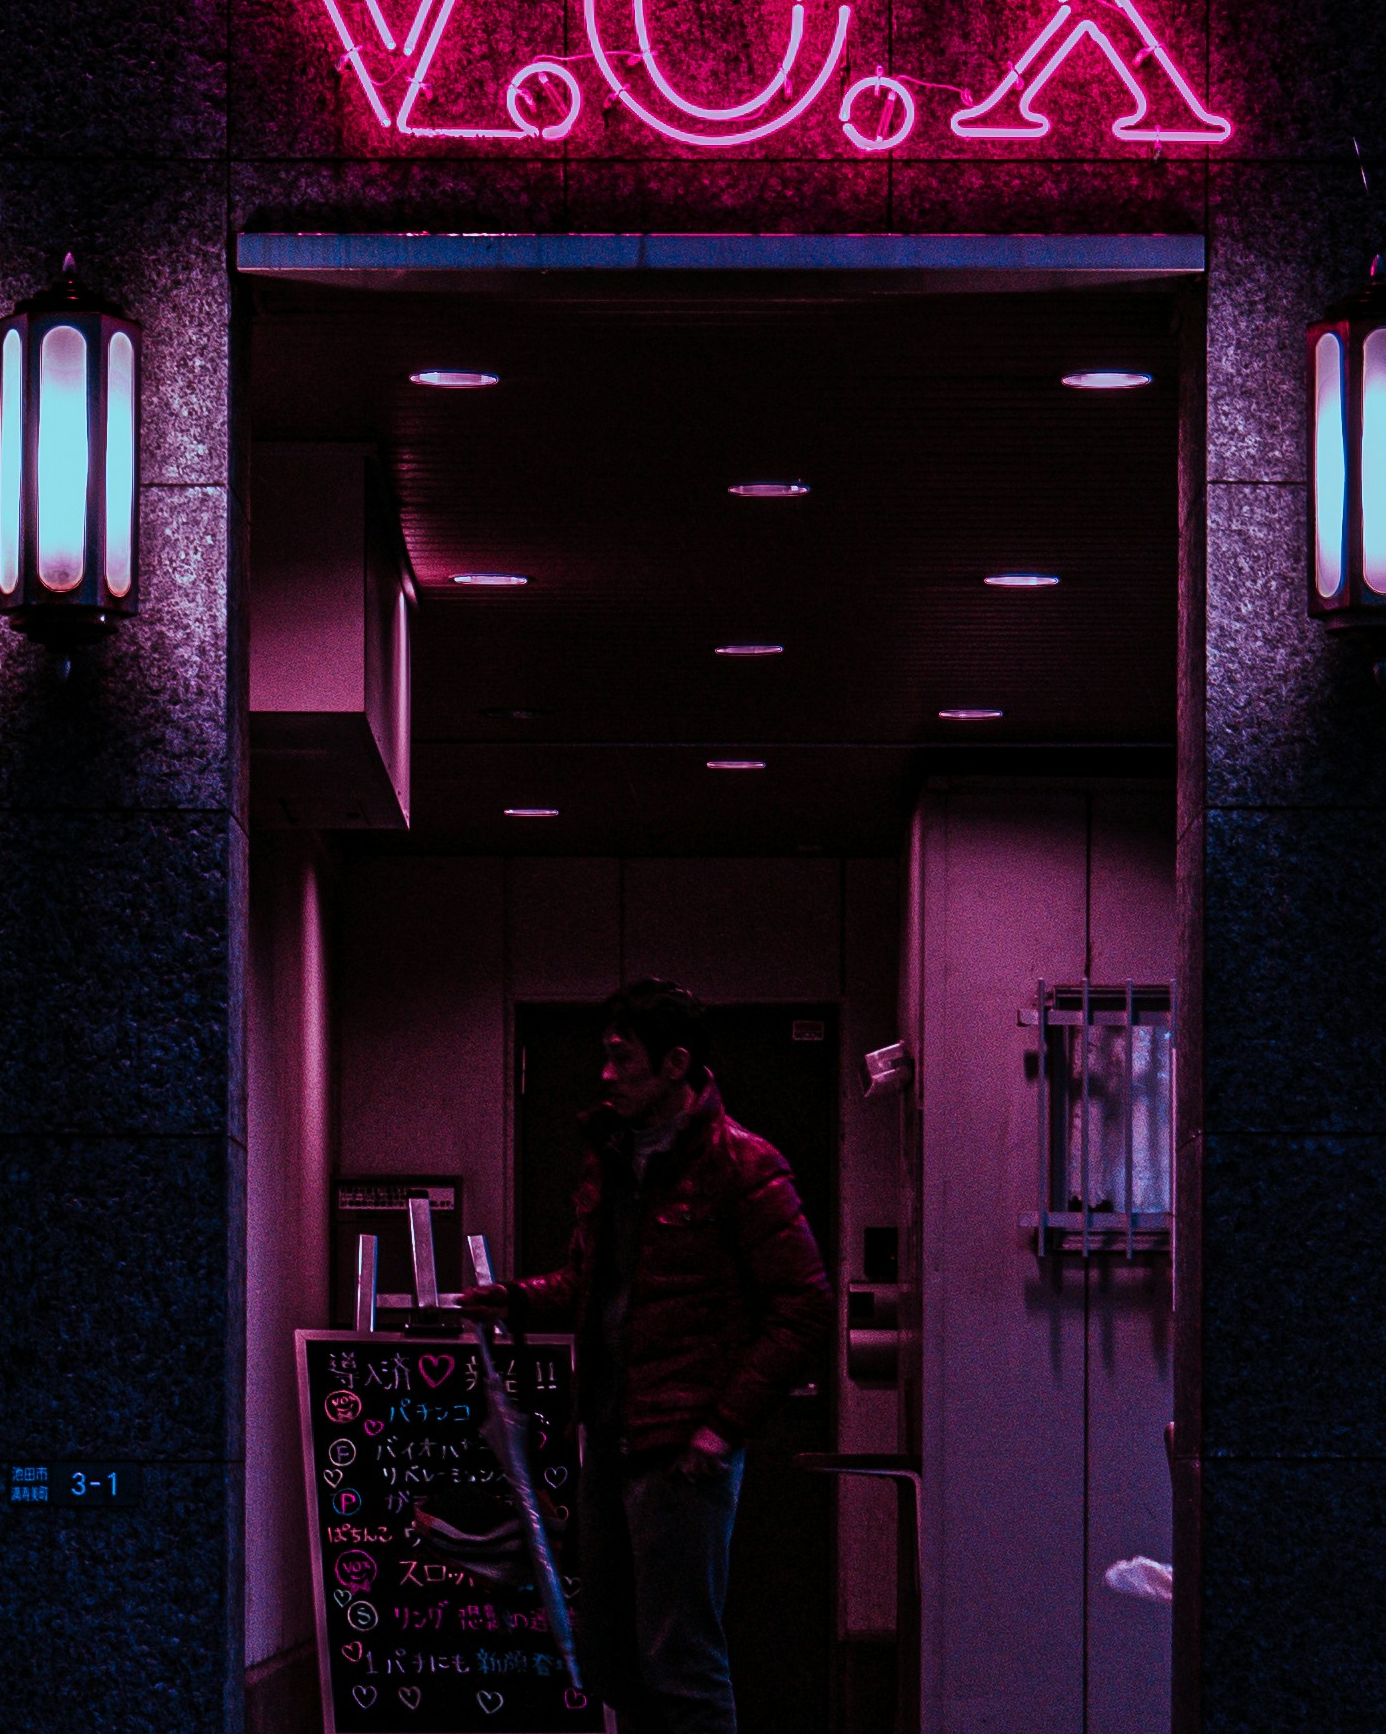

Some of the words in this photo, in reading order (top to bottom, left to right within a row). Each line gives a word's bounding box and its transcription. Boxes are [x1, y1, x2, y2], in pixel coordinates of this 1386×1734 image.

[388, 1396, 473, 1425] パチンコ
[70, 1471, 118, 1497] 3-1
